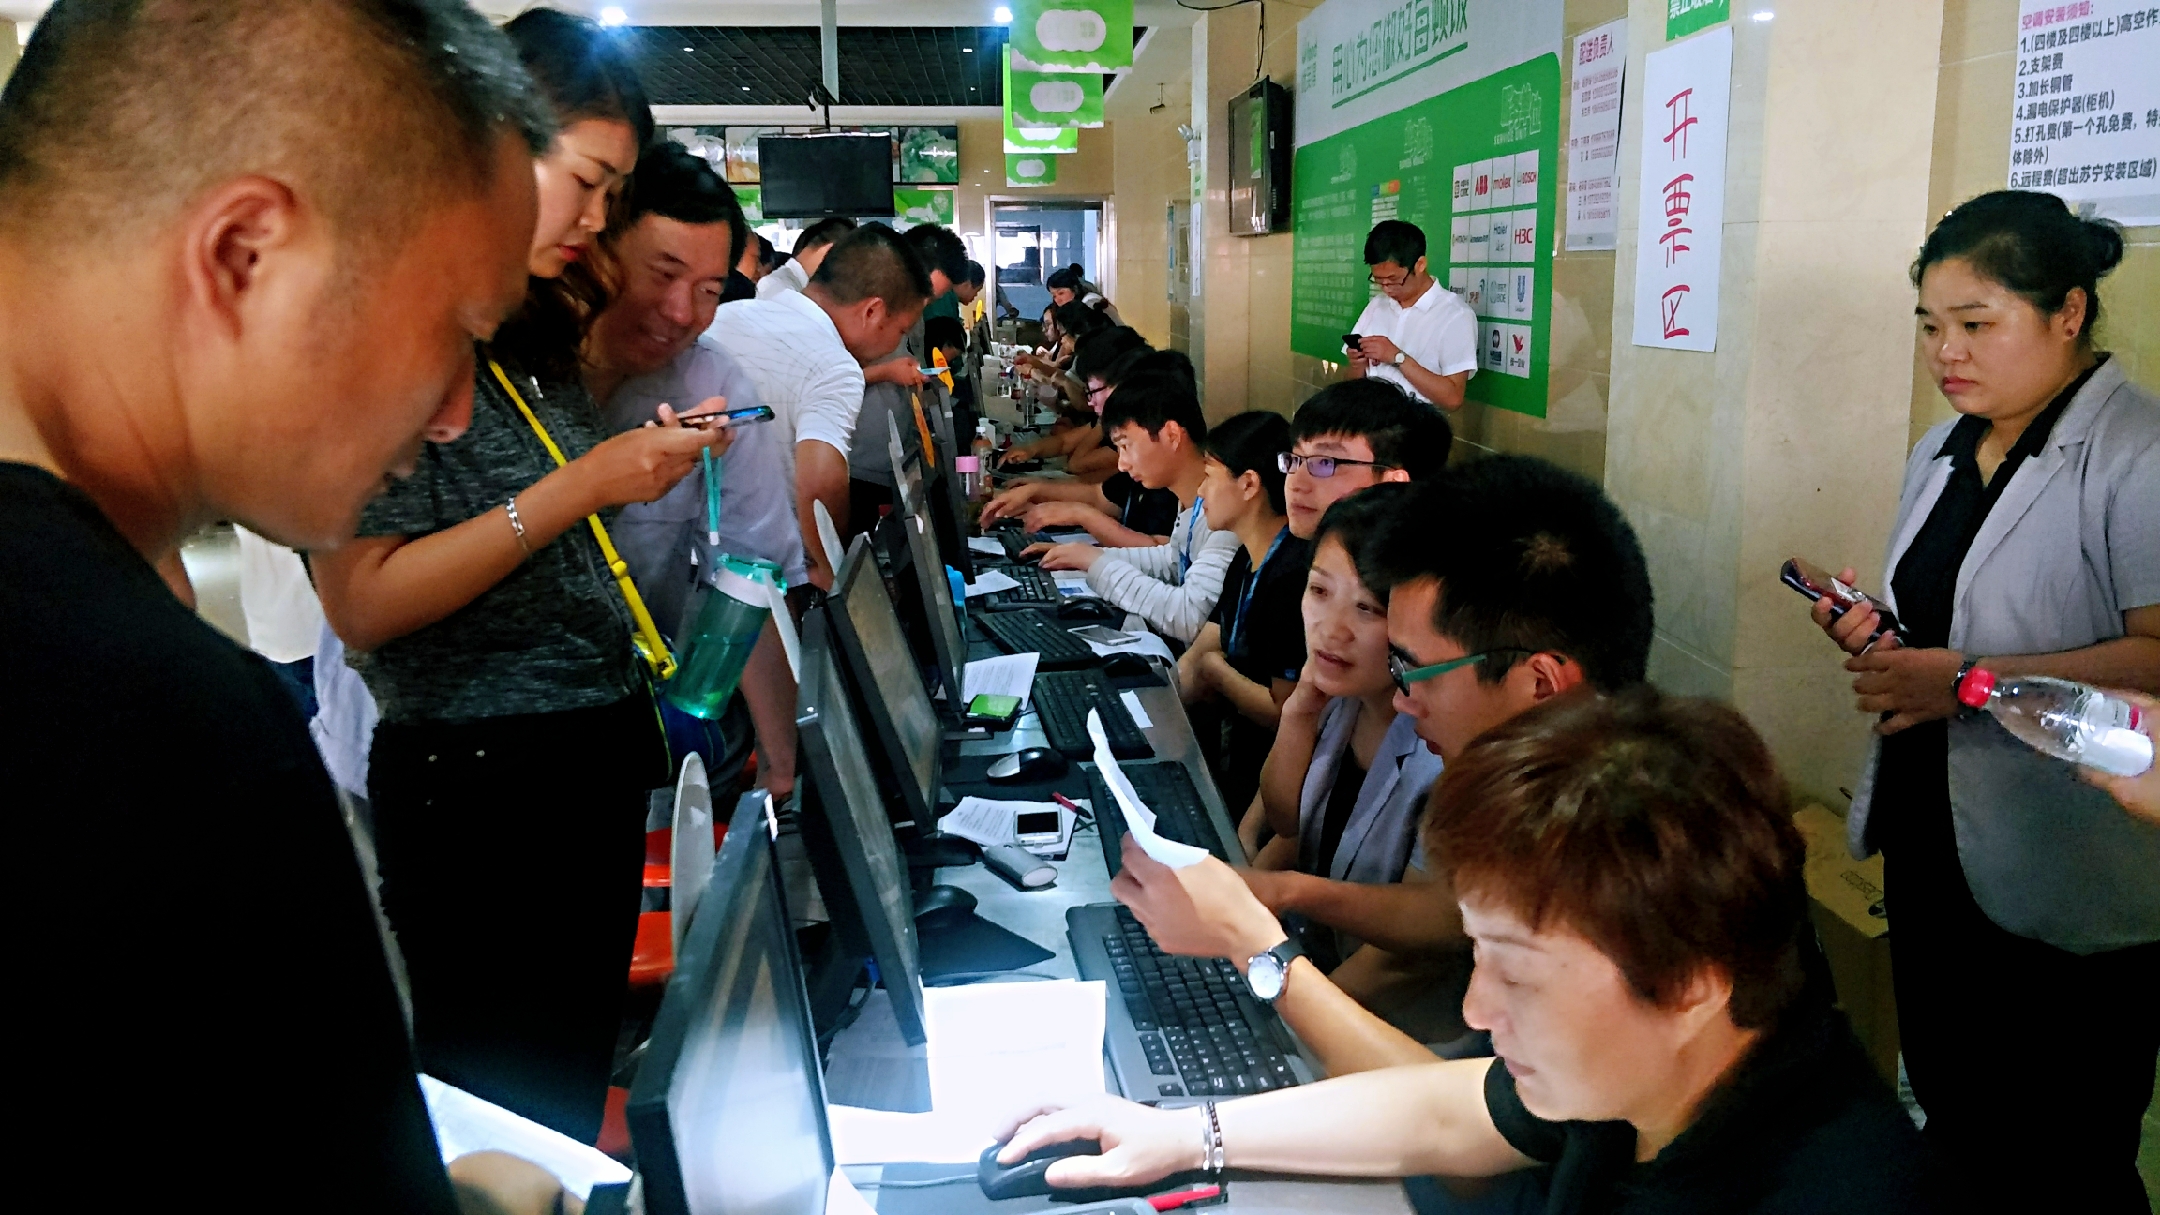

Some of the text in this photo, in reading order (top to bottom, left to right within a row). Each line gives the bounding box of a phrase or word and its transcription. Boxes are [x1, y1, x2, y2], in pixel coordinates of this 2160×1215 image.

[2020, 7, 2160, 54] 1.(四楼及四楼以上)高空作
[2018, 52, 2064, 77] 2.支架费
[2017, 74, 2073, 99] 3.加长铜管
[2015, 89, 2115, 121] 4.漏电保护器(柜机)
[2014, 107, 2160, 144] 5.打孔费(第一个孔免费，特
[2012, 144, 2049, 167] 体除外)
[1493, 173, 1512, 190] molex
[2010, 157, 2158, 188] 6.远程费(超出苏宁安装区域)
[1474, 174, 1488, 197] ABB
[1659, 87, 1699, 340] 开票区
[1514, 227, 1533, 245] H3C
